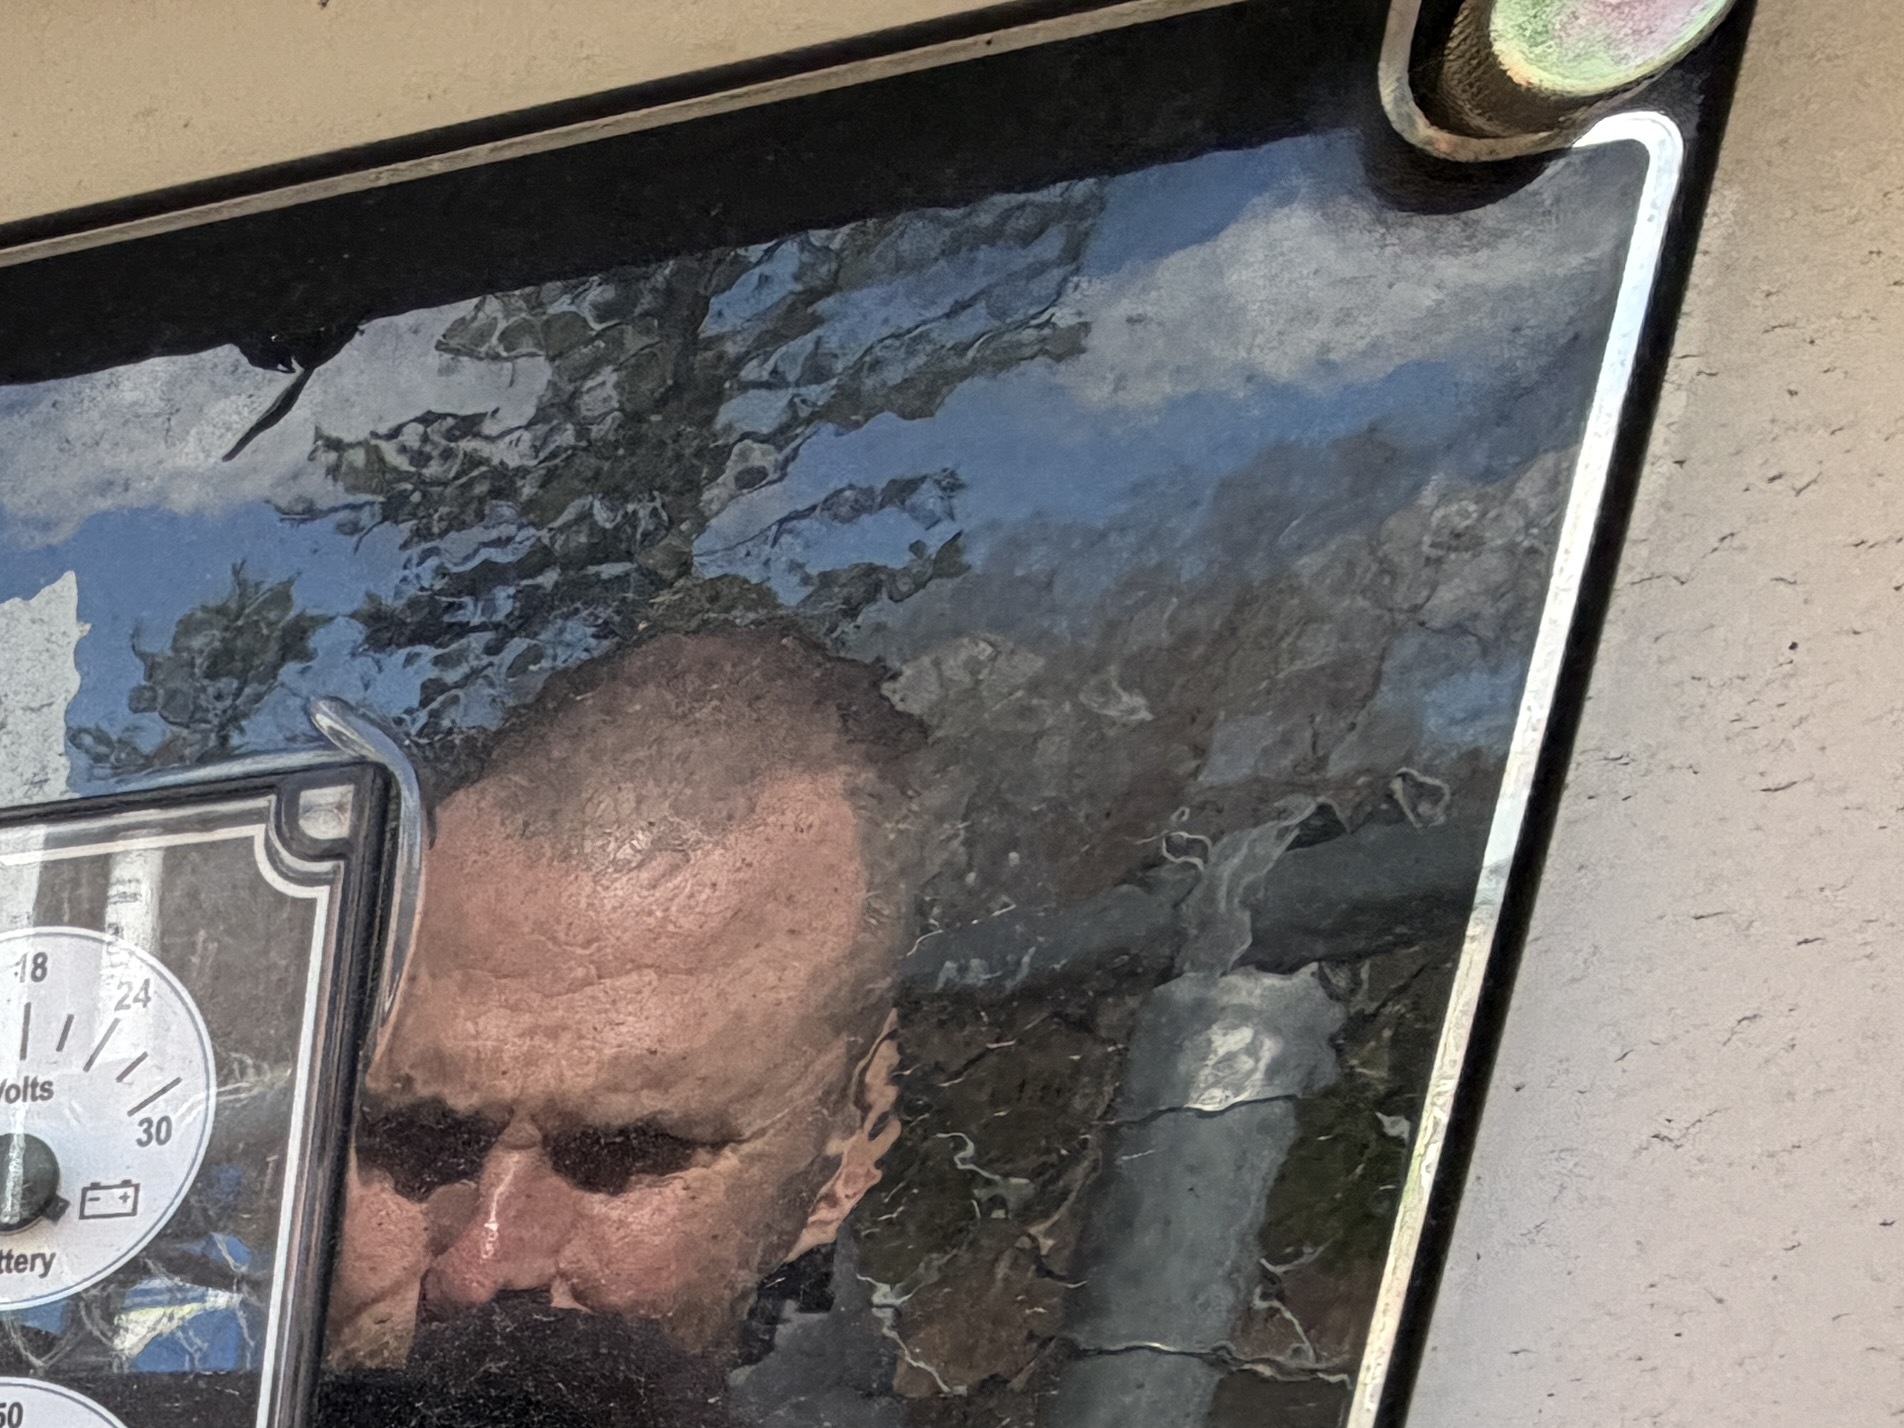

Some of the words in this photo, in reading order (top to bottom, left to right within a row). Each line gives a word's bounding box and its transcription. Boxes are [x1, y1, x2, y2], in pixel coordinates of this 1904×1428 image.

[14, 952, 48, 983] 18
[114, 978, 151, 1011] 24
[136, 1116, 172, 1148] 30
